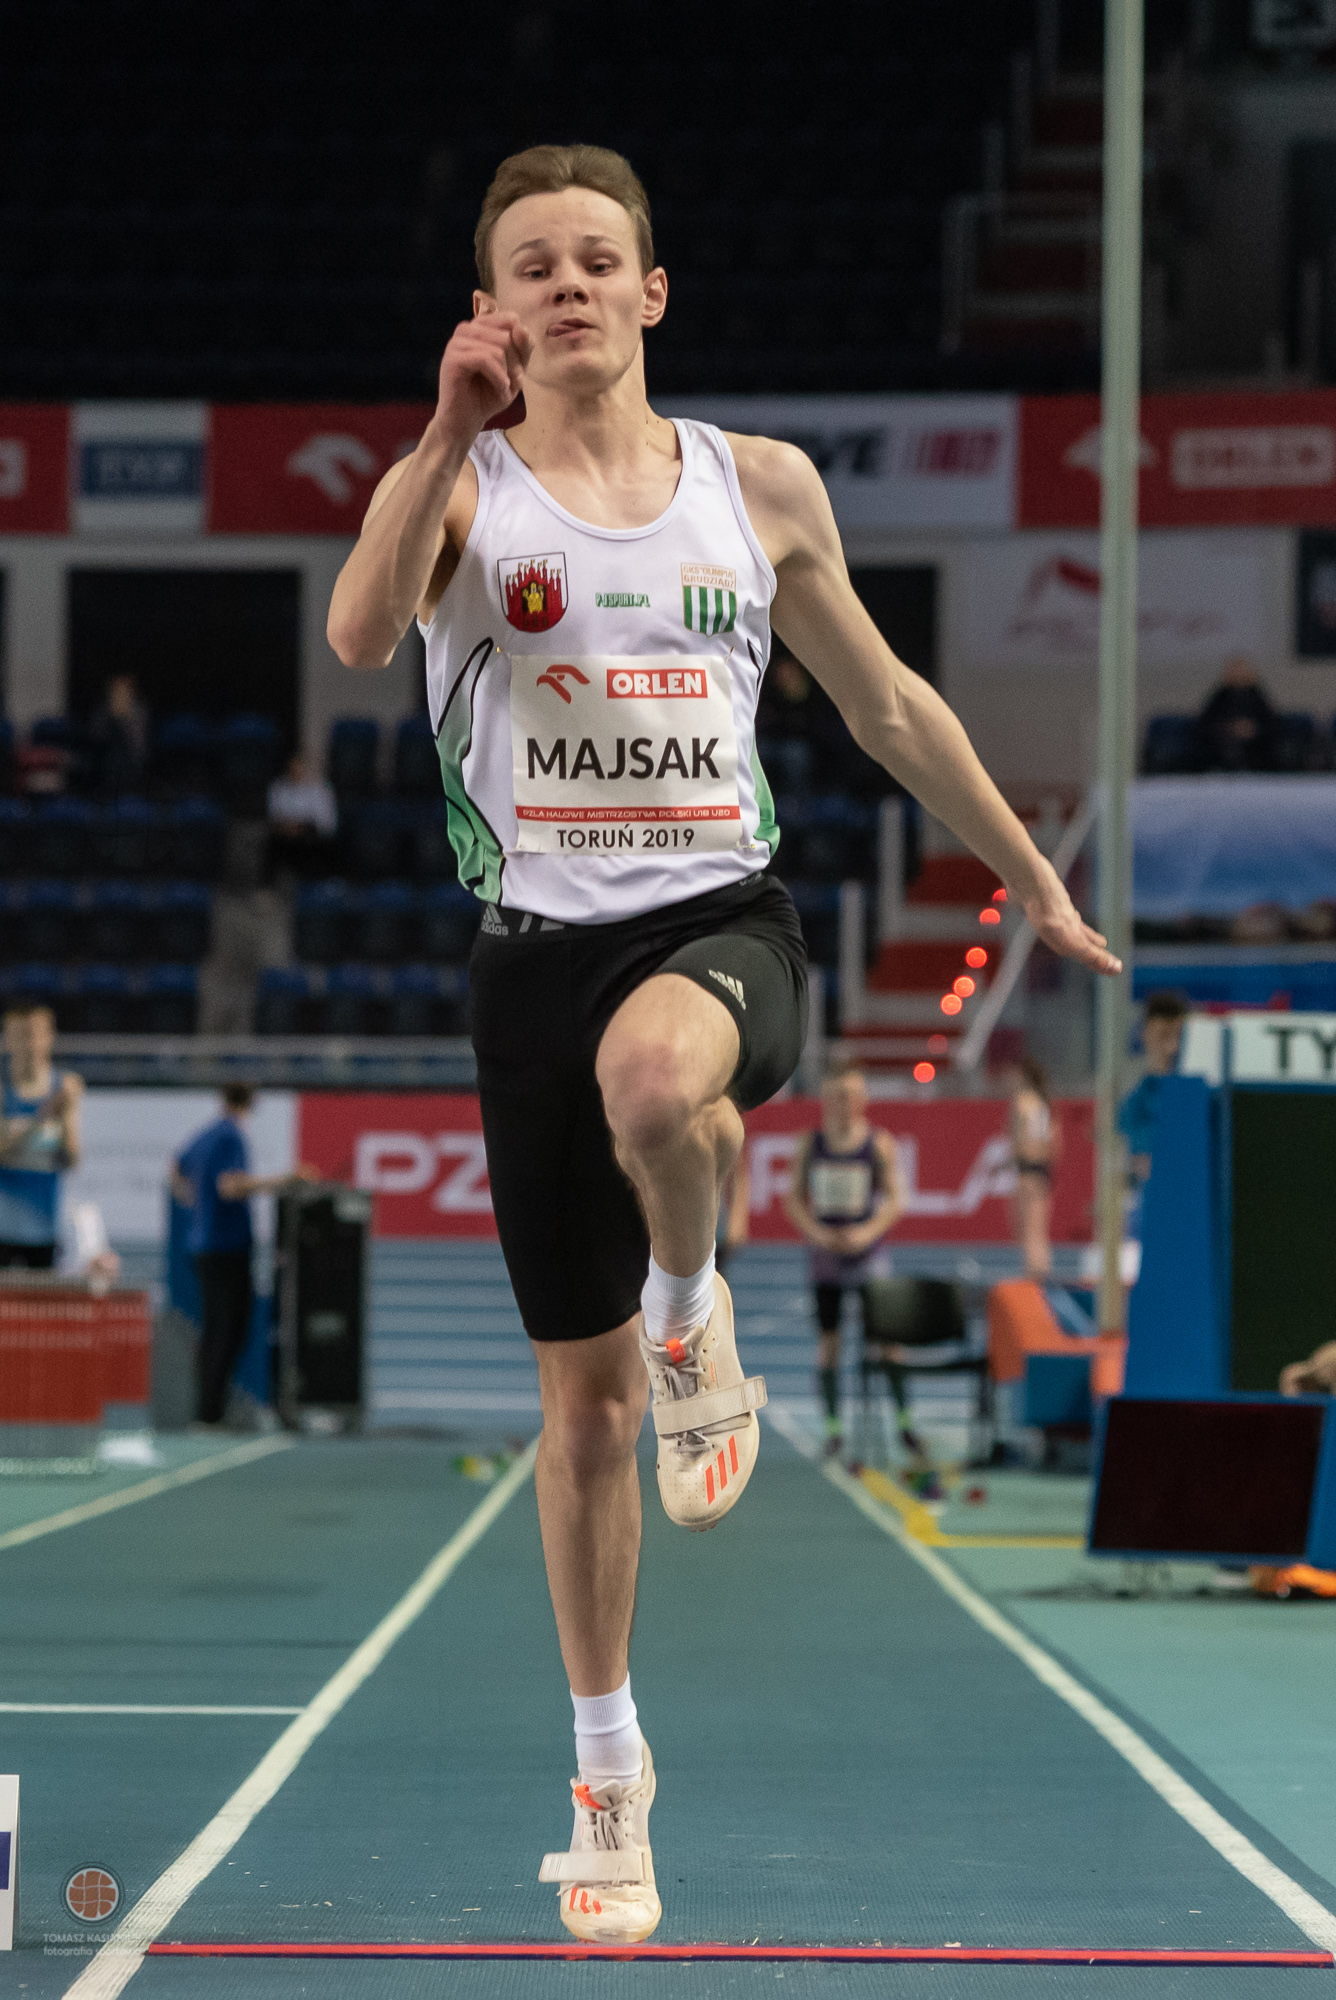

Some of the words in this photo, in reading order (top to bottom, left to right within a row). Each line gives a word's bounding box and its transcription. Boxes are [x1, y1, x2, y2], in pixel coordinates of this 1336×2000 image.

[683, 565, 699, 574] GKS
[612, 672, 702, 696] ORLEN
[526, 737, 720, 780] MAJSAK
[522, 809, 545, 818] PZLA
[546, 810, 585, 819] HALOWE
[587, 810, 657, 819] MISTRZOSTWA
[659, 809, 692, 818] POLSKI
[693, 809, 709, 817] U18
[711, 808, 731, 817] U20
[557, 823, 634, 849] TORUŃ
[642, 827, 695, 848] 2019
[1264, 1024, 1336, 1071] TY
[751, 1133, 1020, 1217] PLA
